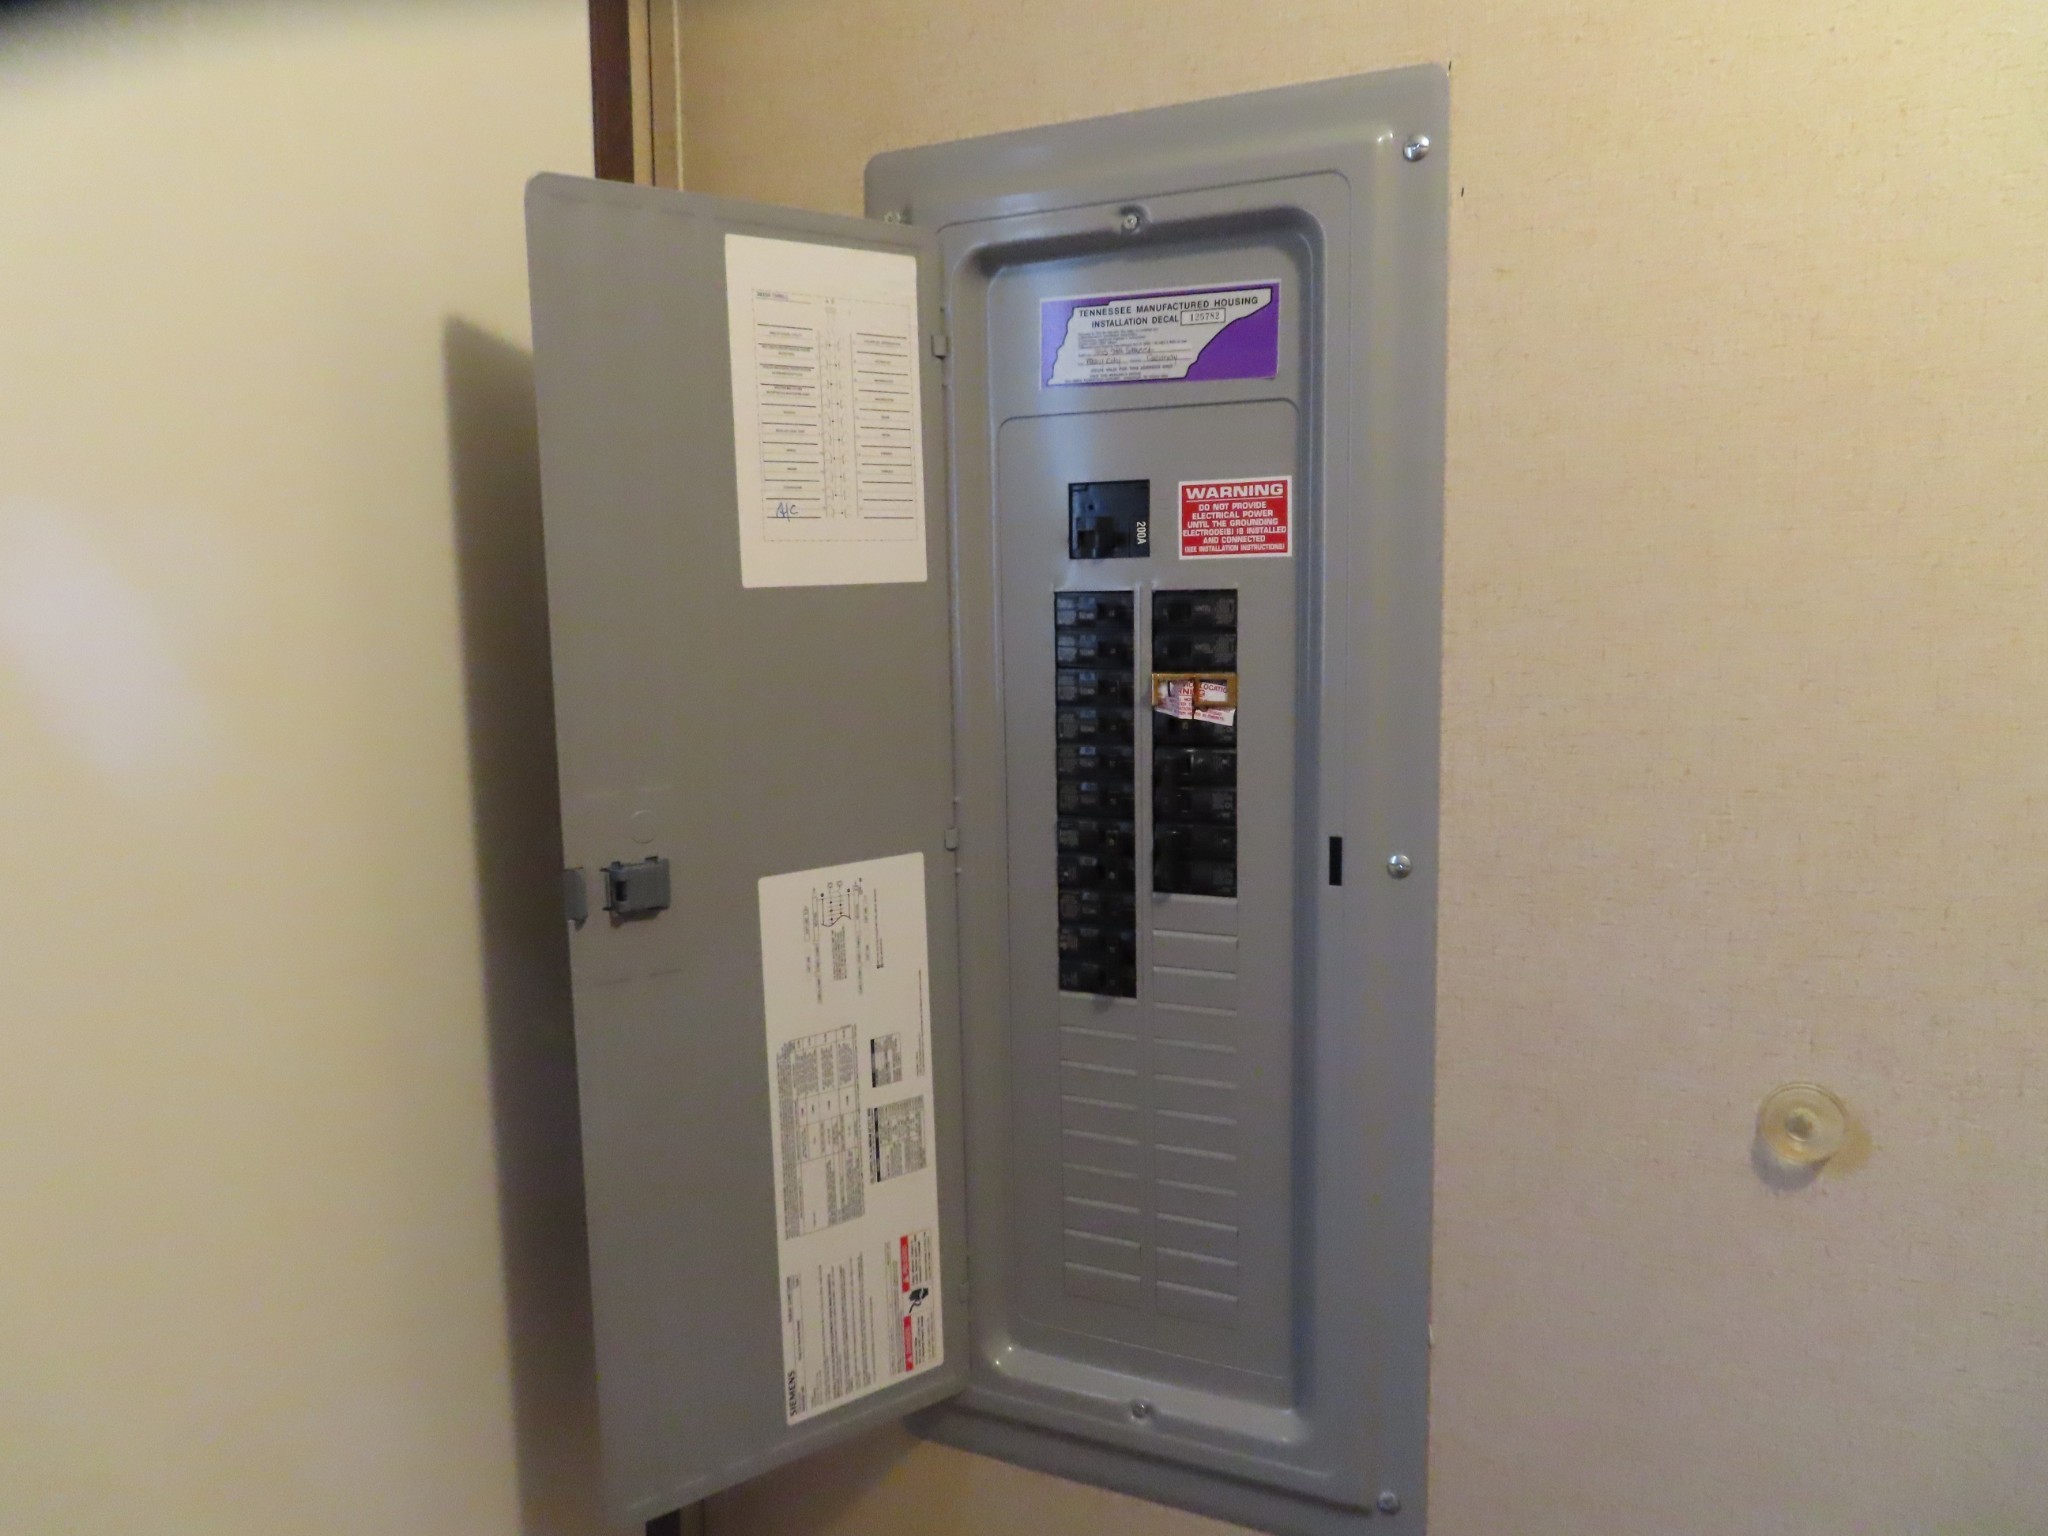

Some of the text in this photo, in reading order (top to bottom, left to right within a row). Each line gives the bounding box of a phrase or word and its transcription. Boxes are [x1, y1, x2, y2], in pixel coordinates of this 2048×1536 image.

[1079, 296, 1258, 317] TENNESSEE MANUFACTURED HOUSING
[1092, 316, 1148, 328] INSTALLATION
[1151, 314, 1179, 325] DECAL
[1185, 483, 1284, 499] WARNING
[1232, 501, 1267, 510] PROVIDE
[1192, 509, 1274, 520] ELECTRICAL POWER
[1187, 518, 1279, 529] UNTIL THE GROUNDING
[1136, 521, 1147, 545] 200A
[1246, 525, 1287, 534] INSTALLED
[1203, 535, 1266, 544] AND CONNECTED
[1198, 544, 1239, 552] INSTALLATION
[787, 1370, 798, 1417] SIEMENS
